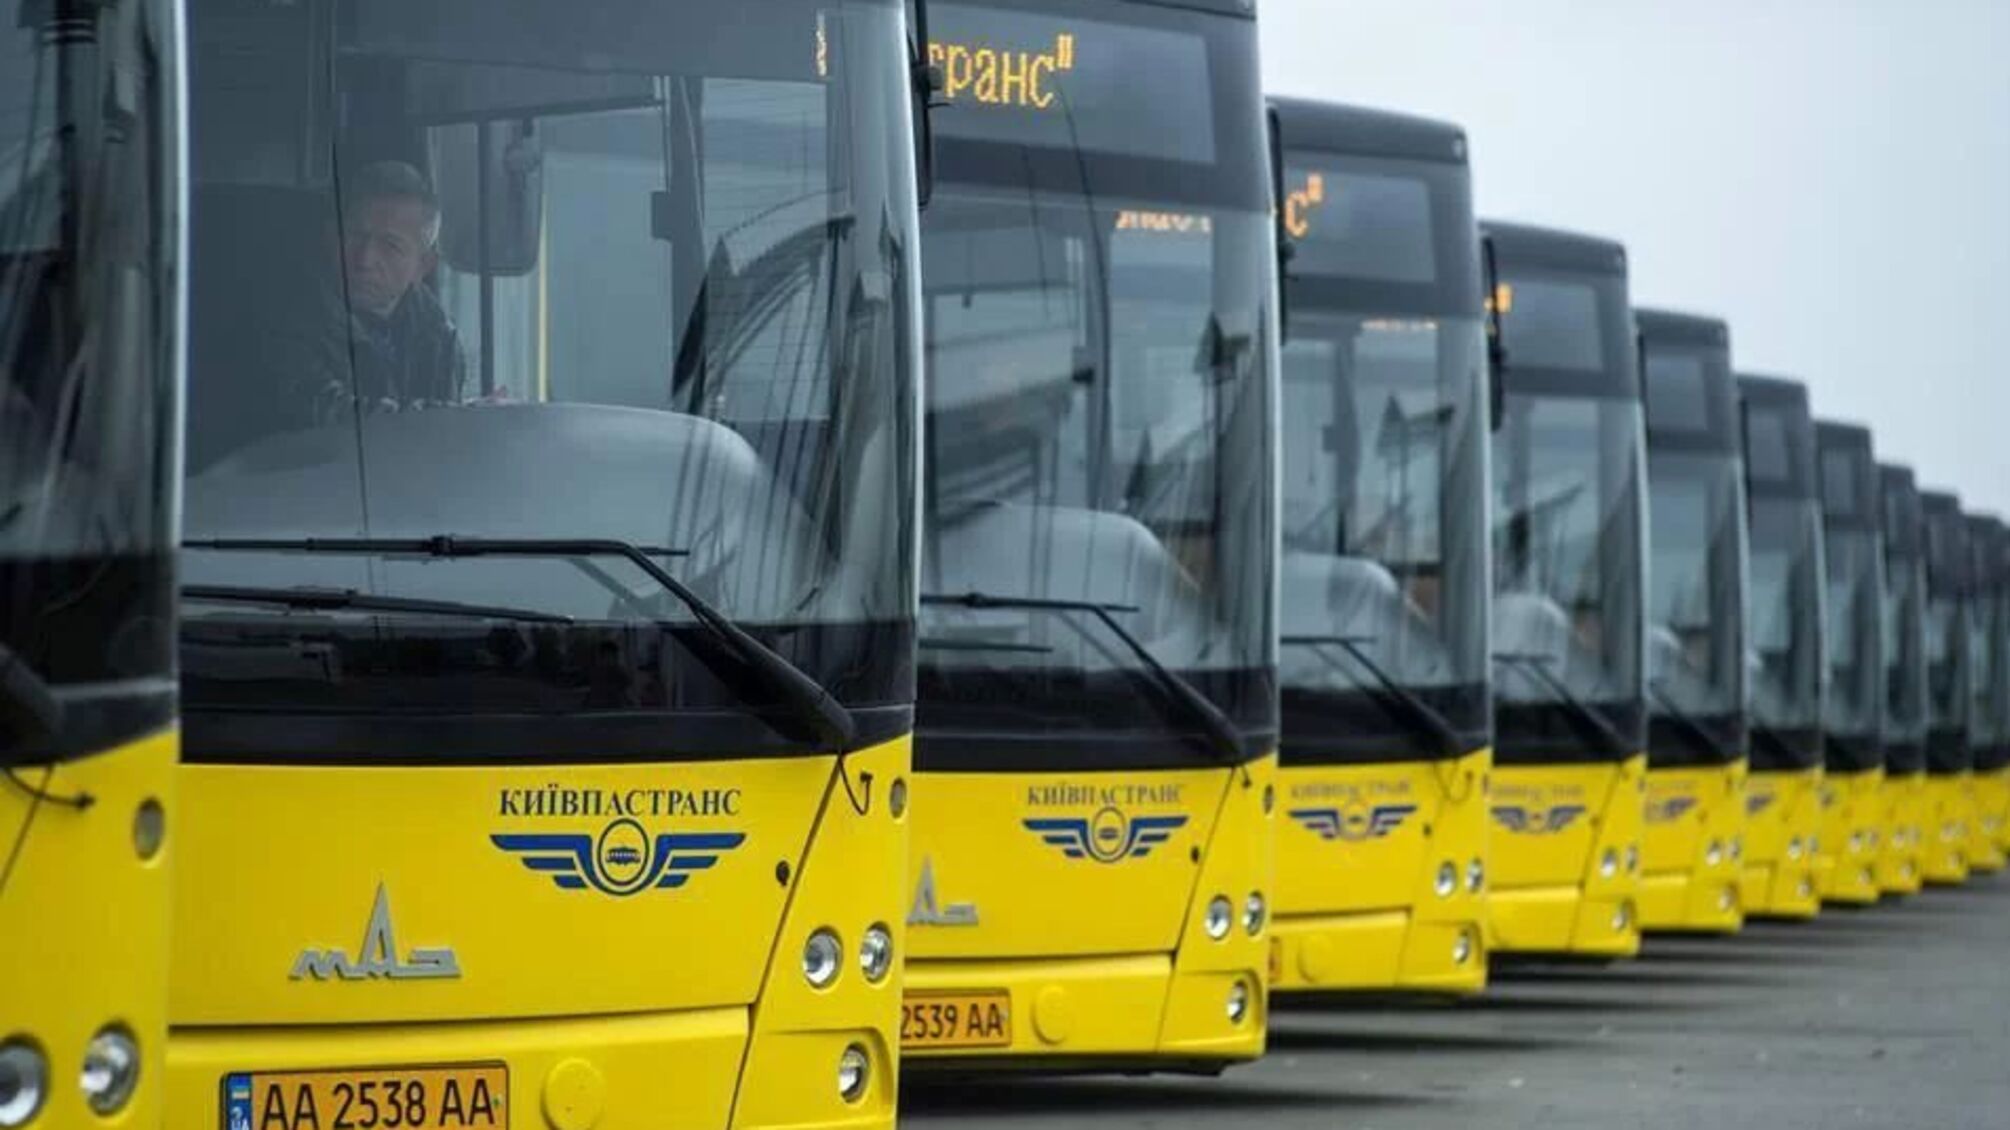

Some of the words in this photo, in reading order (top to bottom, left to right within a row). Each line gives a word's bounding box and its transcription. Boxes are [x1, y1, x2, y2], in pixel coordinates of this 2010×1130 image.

[499, 783, 742, 817] КИЇВПАСТРАНС
[901, 1003, 958, 1040] 2539
[331, 1080, 427, 1129] 2538
